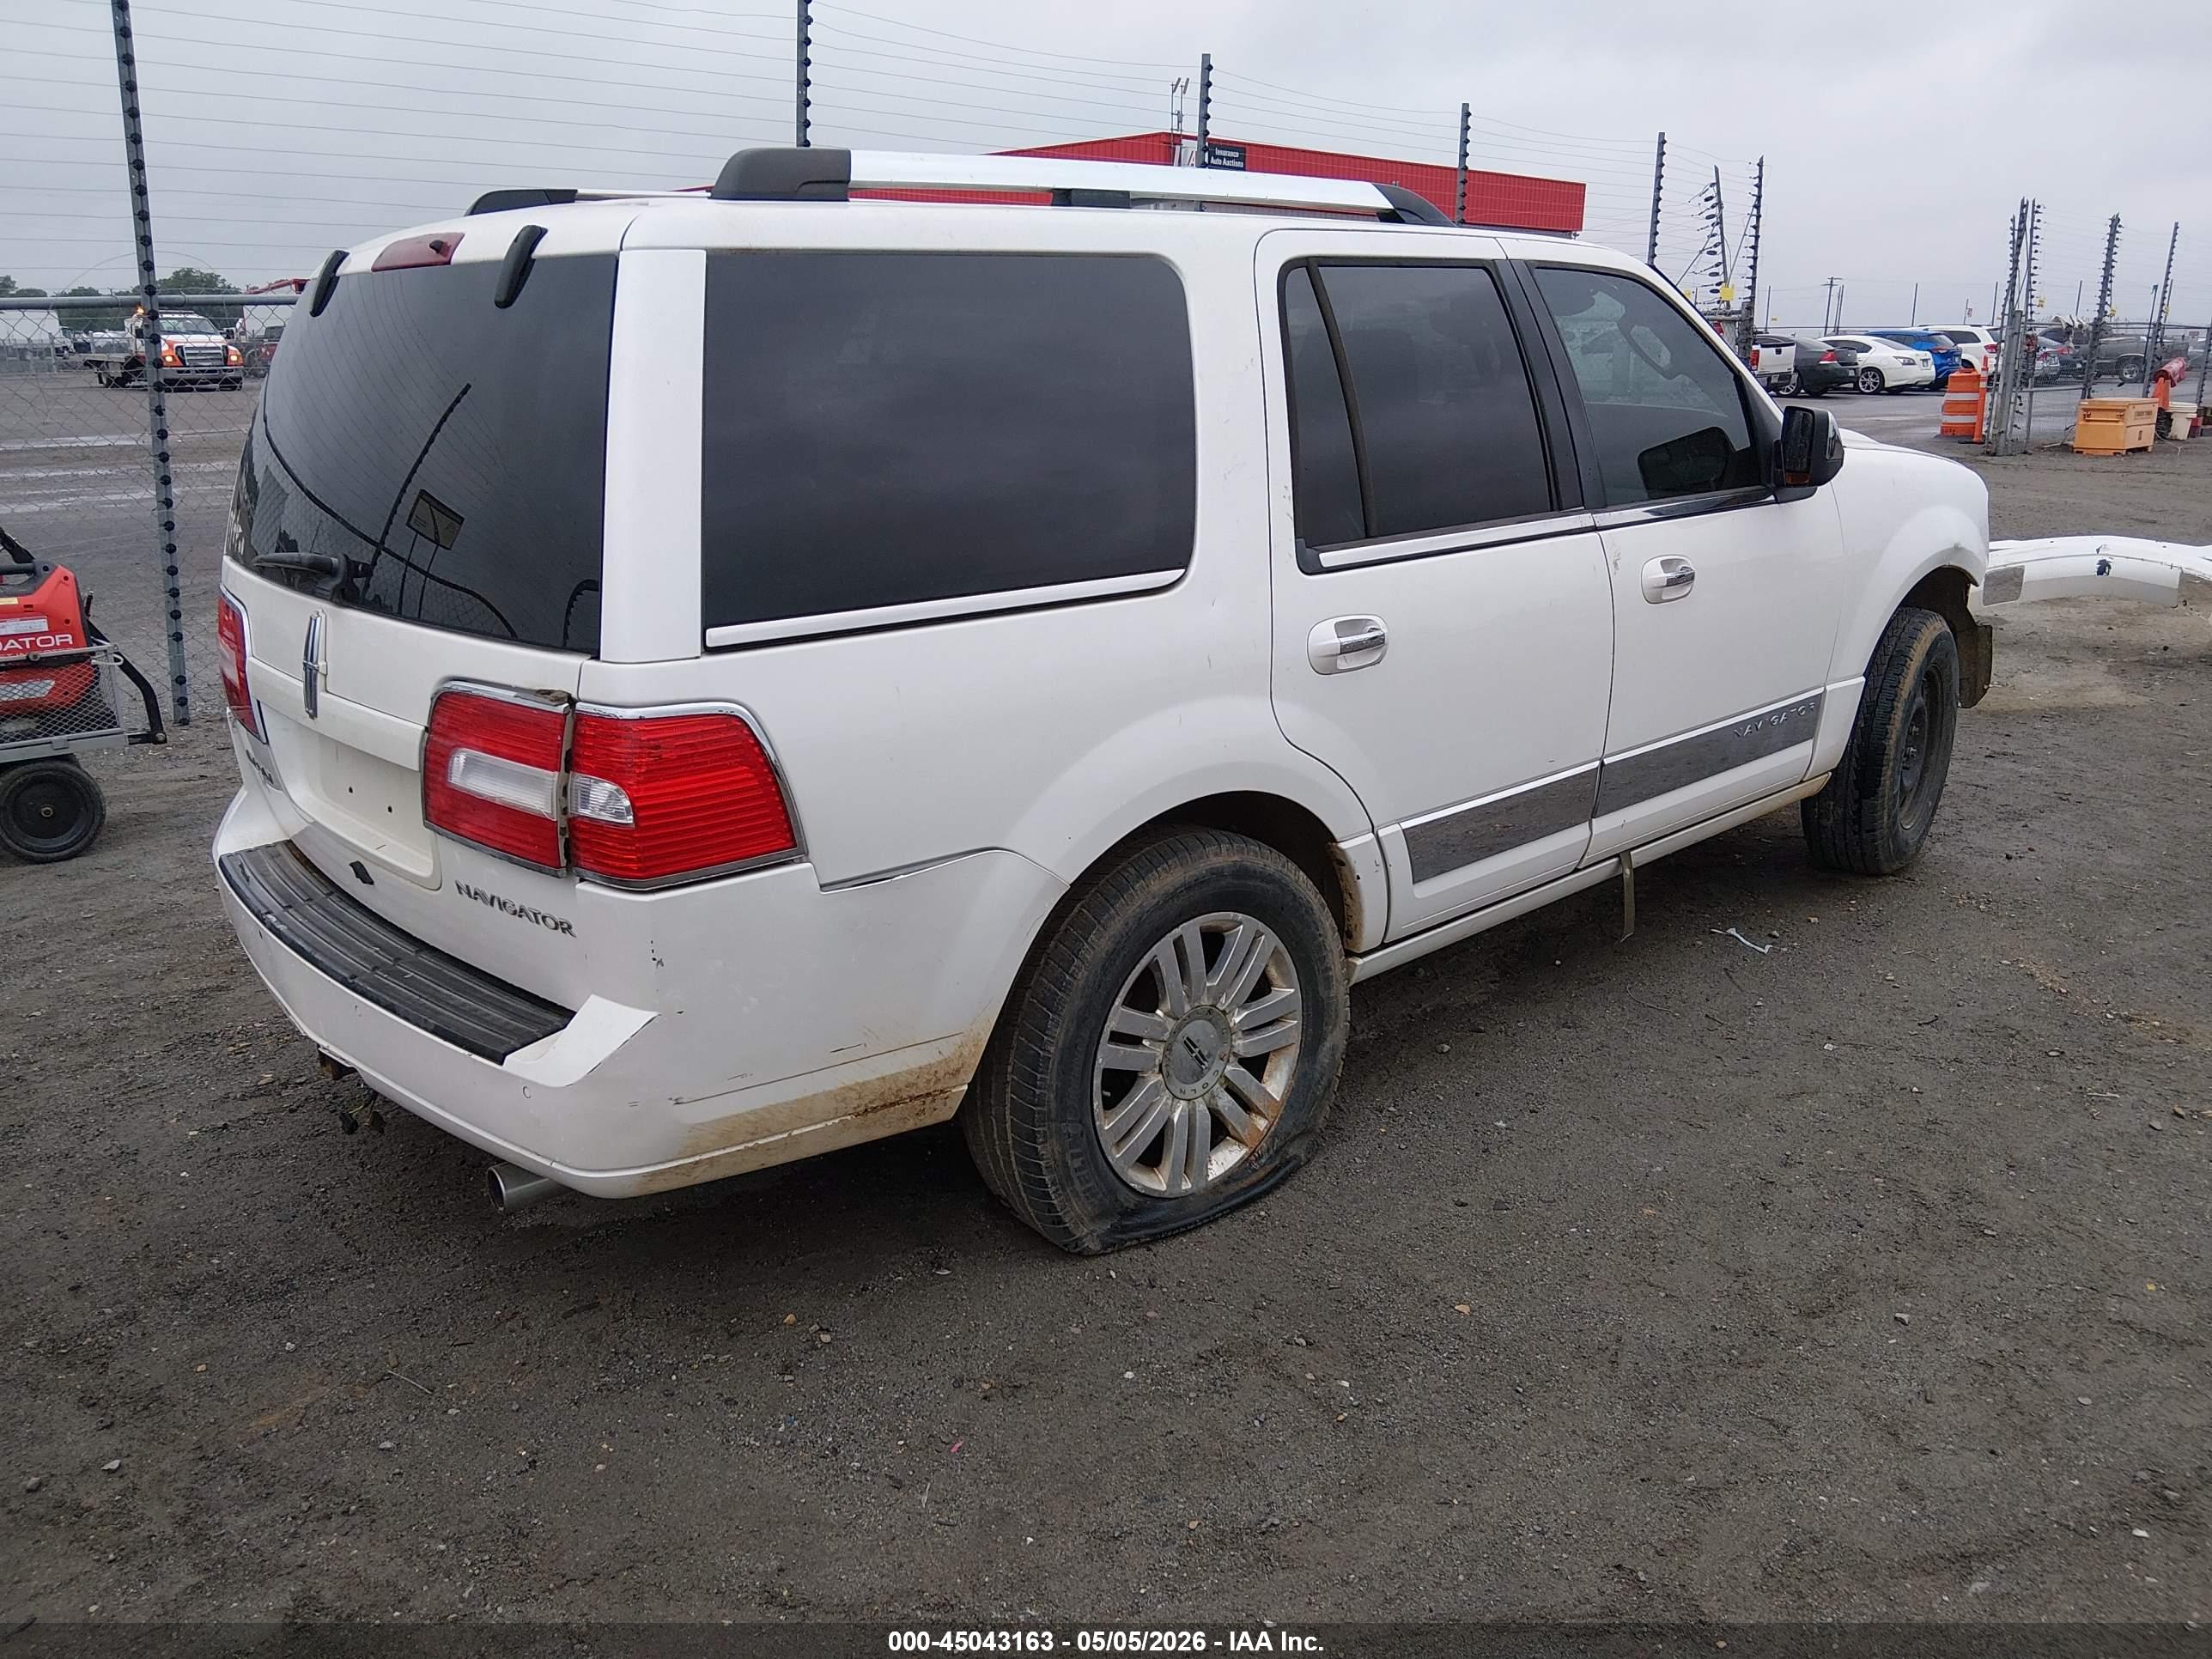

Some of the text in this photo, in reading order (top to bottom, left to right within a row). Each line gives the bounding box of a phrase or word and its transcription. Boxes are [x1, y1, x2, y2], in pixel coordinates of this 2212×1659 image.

[1211, 155, 1244, 168] Auto Auctions
[1215, 147, 1239, 158] Insurance
[1733, 702, 1815, 738] NAVGAOR
[454, 878, 578, 939] NAVIGATOR
